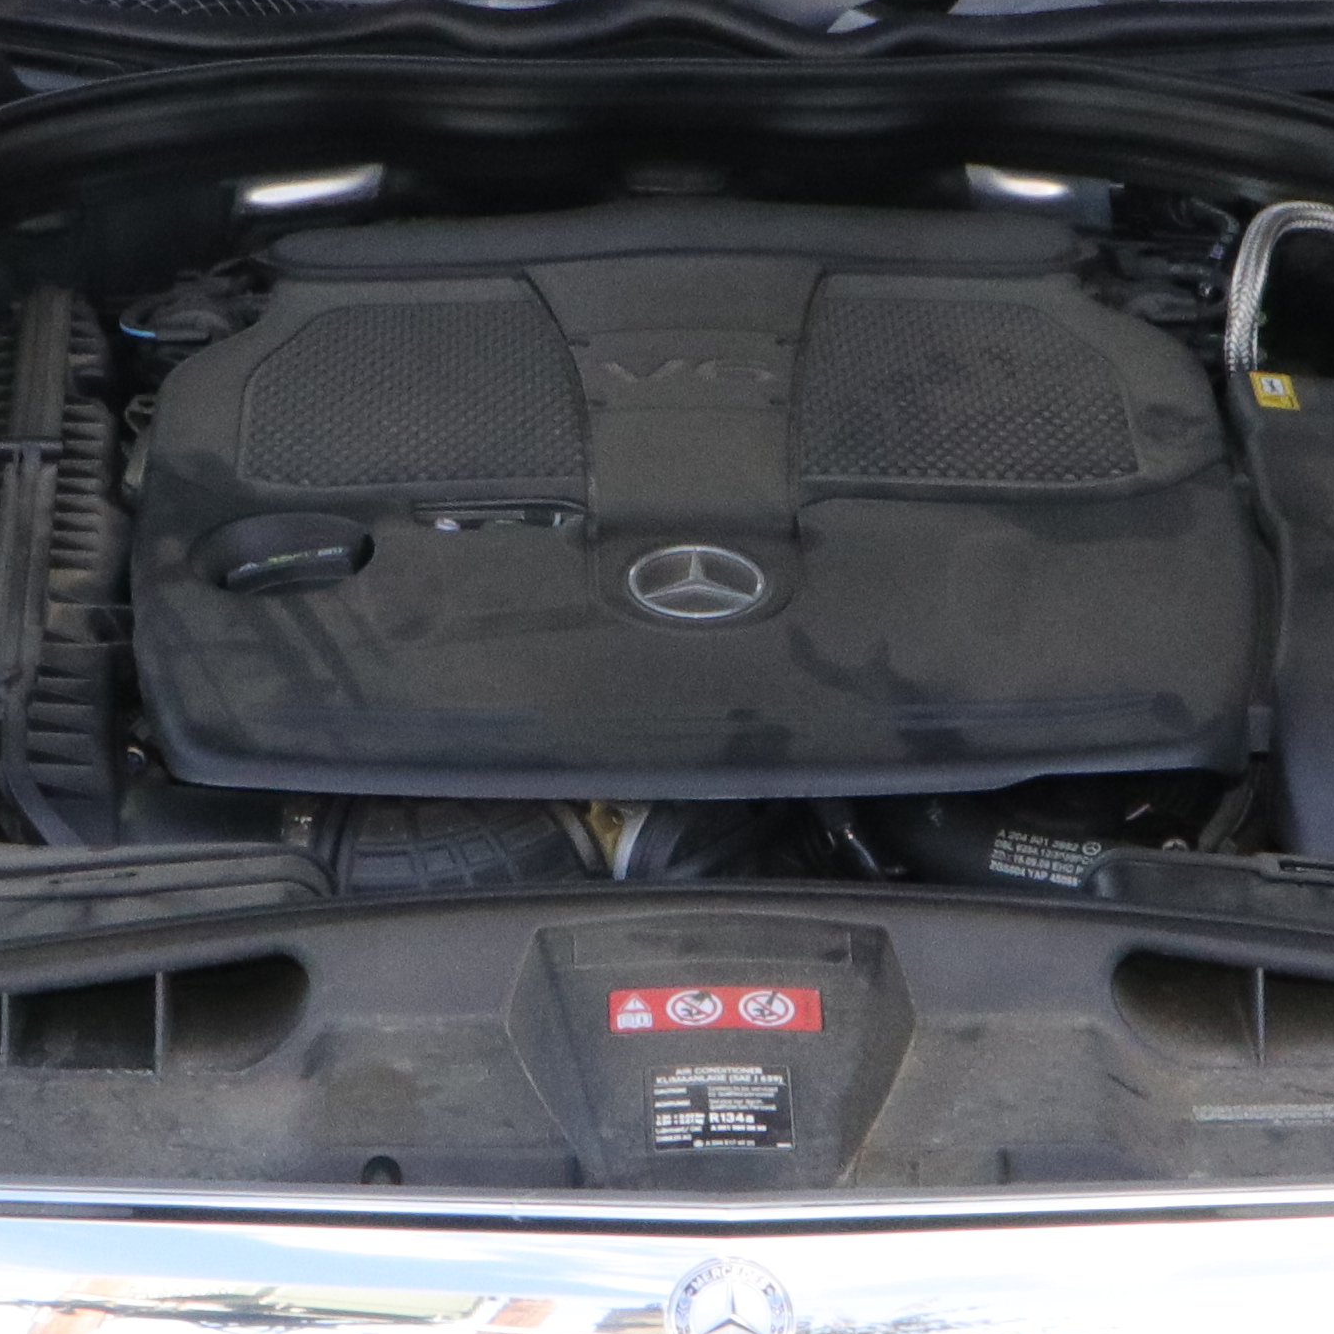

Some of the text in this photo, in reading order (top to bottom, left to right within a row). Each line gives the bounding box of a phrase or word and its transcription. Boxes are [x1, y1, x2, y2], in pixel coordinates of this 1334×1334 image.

[675, 1066, 763, 1076] AIR CONDITIONER
[656, 1074, 727, 1084] KLIMAANLAGE
[709, 1111, 756, 1124] R134a
[690, 1266, 770, 1291] MERCEDES
